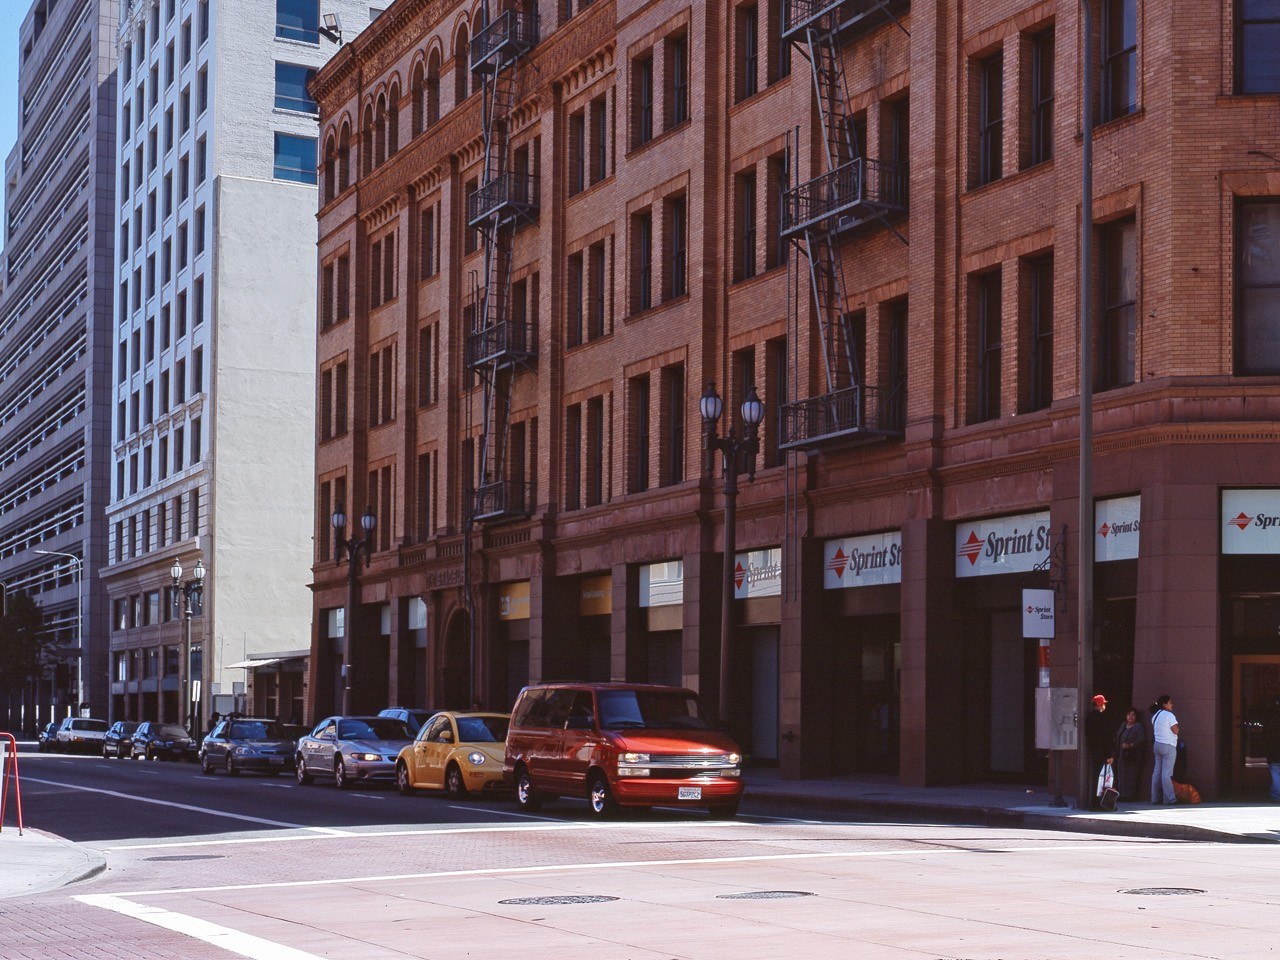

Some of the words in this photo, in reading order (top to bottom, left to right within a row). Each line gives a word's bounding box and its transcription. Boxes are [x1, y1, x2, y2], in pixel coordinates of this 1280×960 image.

[1110, 521, 1133, 537] Sprint
[985, 528, 1034, 564] Sprint
[850, 545, 888, 576] Sprint
[1035, 606, 1051, 614] Sprint
